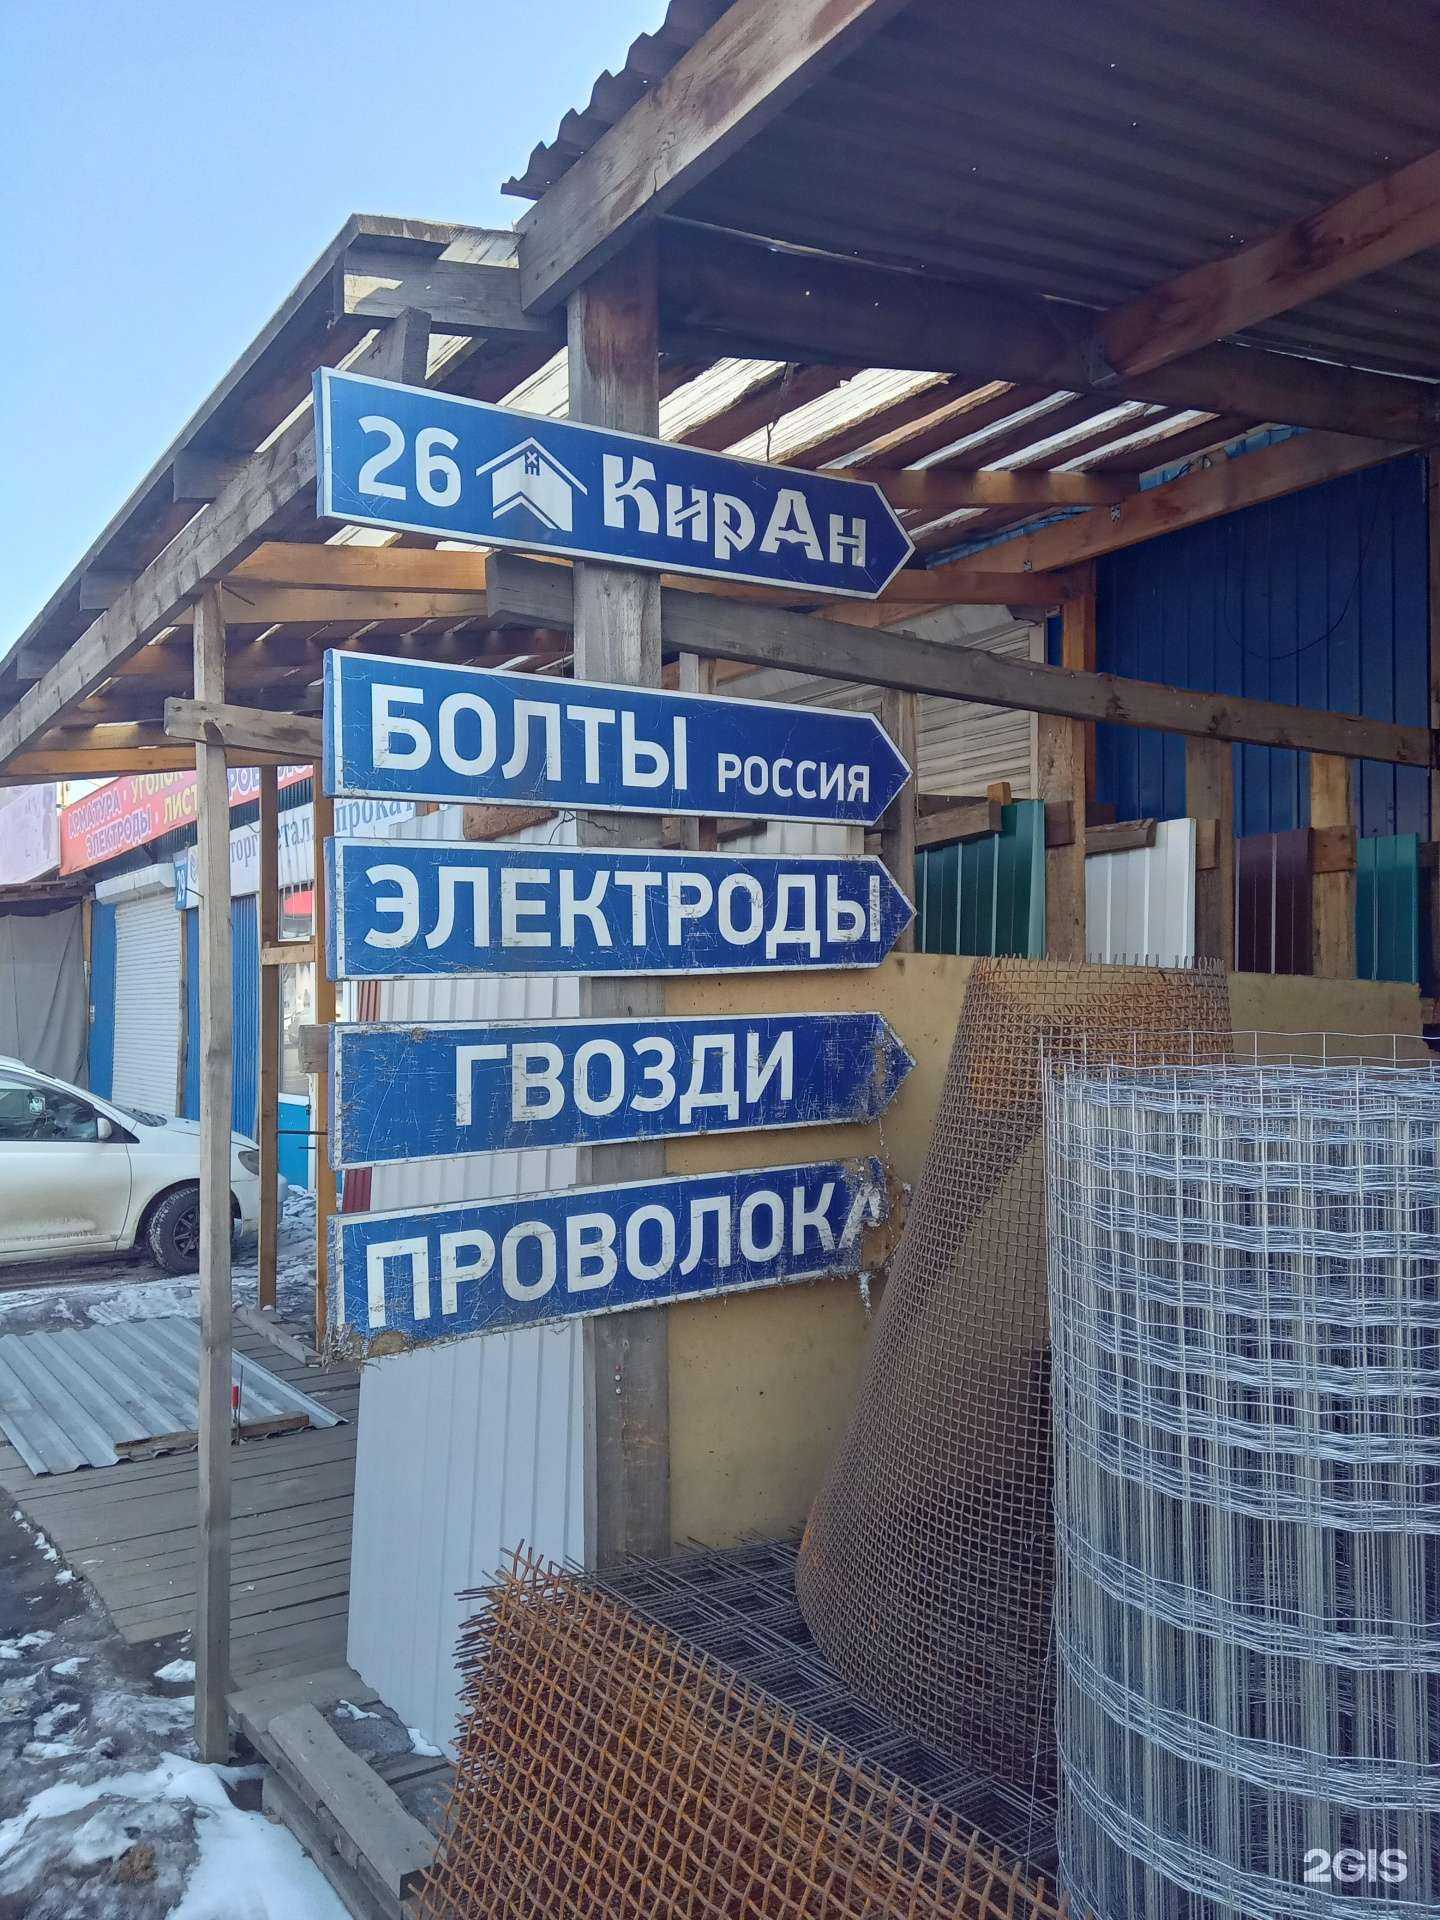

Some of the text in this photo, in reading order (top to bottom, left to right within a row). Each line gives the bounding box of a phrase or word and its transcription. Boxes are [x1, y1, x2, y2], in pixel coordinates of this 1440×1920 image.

[357, 415, 462, 508] 26
[370, 683, 871, 803] БОЛТЫ РОССИЯ
[68, 788, 121, 838] АРМАТУРА
[86, 804, 152, 859] ЭЛЕКТРОДЫ
[363, 864, 880, 960] ЭЛЕКТРОДЫ
[455, 1031, 794, 1127] ГВОЗДИ
[366, 1182, 882, 1329] ПРОВОЛОКА
